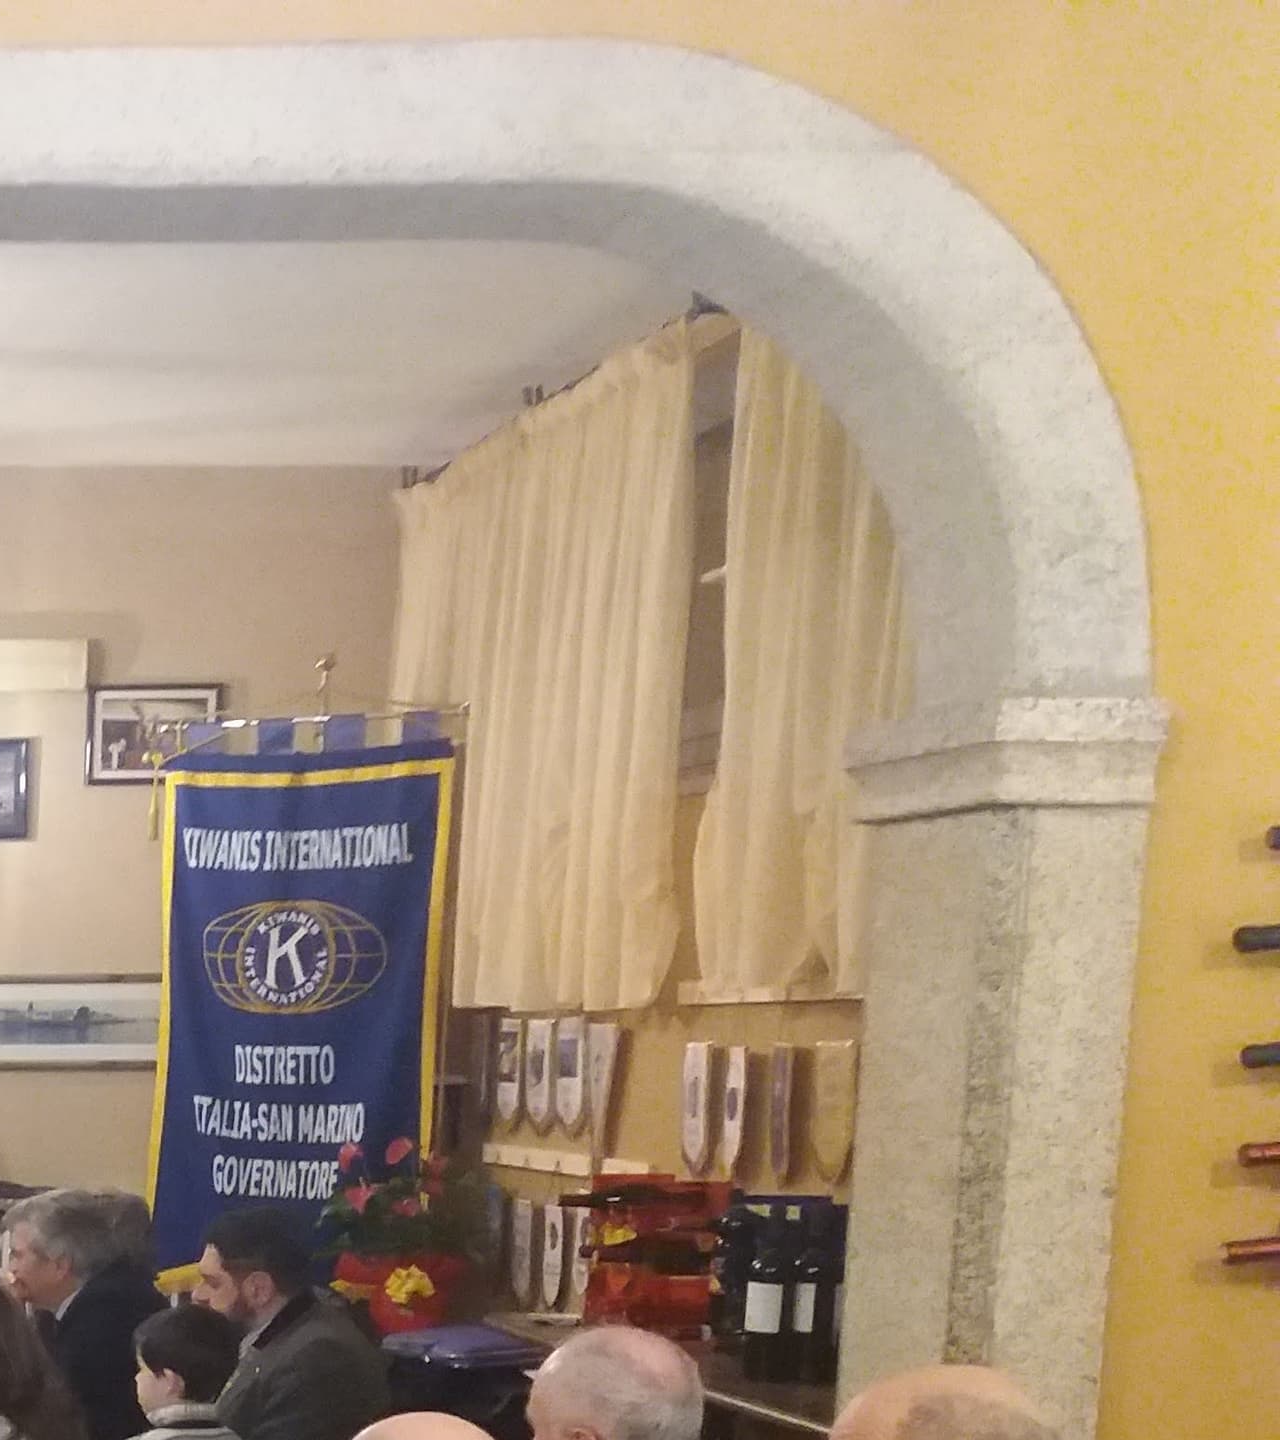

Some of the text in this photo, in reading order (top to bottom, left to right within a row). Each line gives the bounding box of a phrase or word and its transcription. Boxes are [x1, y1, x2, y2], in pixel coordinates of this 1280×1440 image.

[262, 822, 414, 872] INTERNATIONAL
[257, 910, 321, 936] KIWANIS
[263, 924, 310, 991] K
[234, 1044, 336, 1085] DISTRETTO
[192, 1094, 366, 1144] ITALIA-SAN MARINO
[212, 1154, 340, 1200] GOVERNATORE
